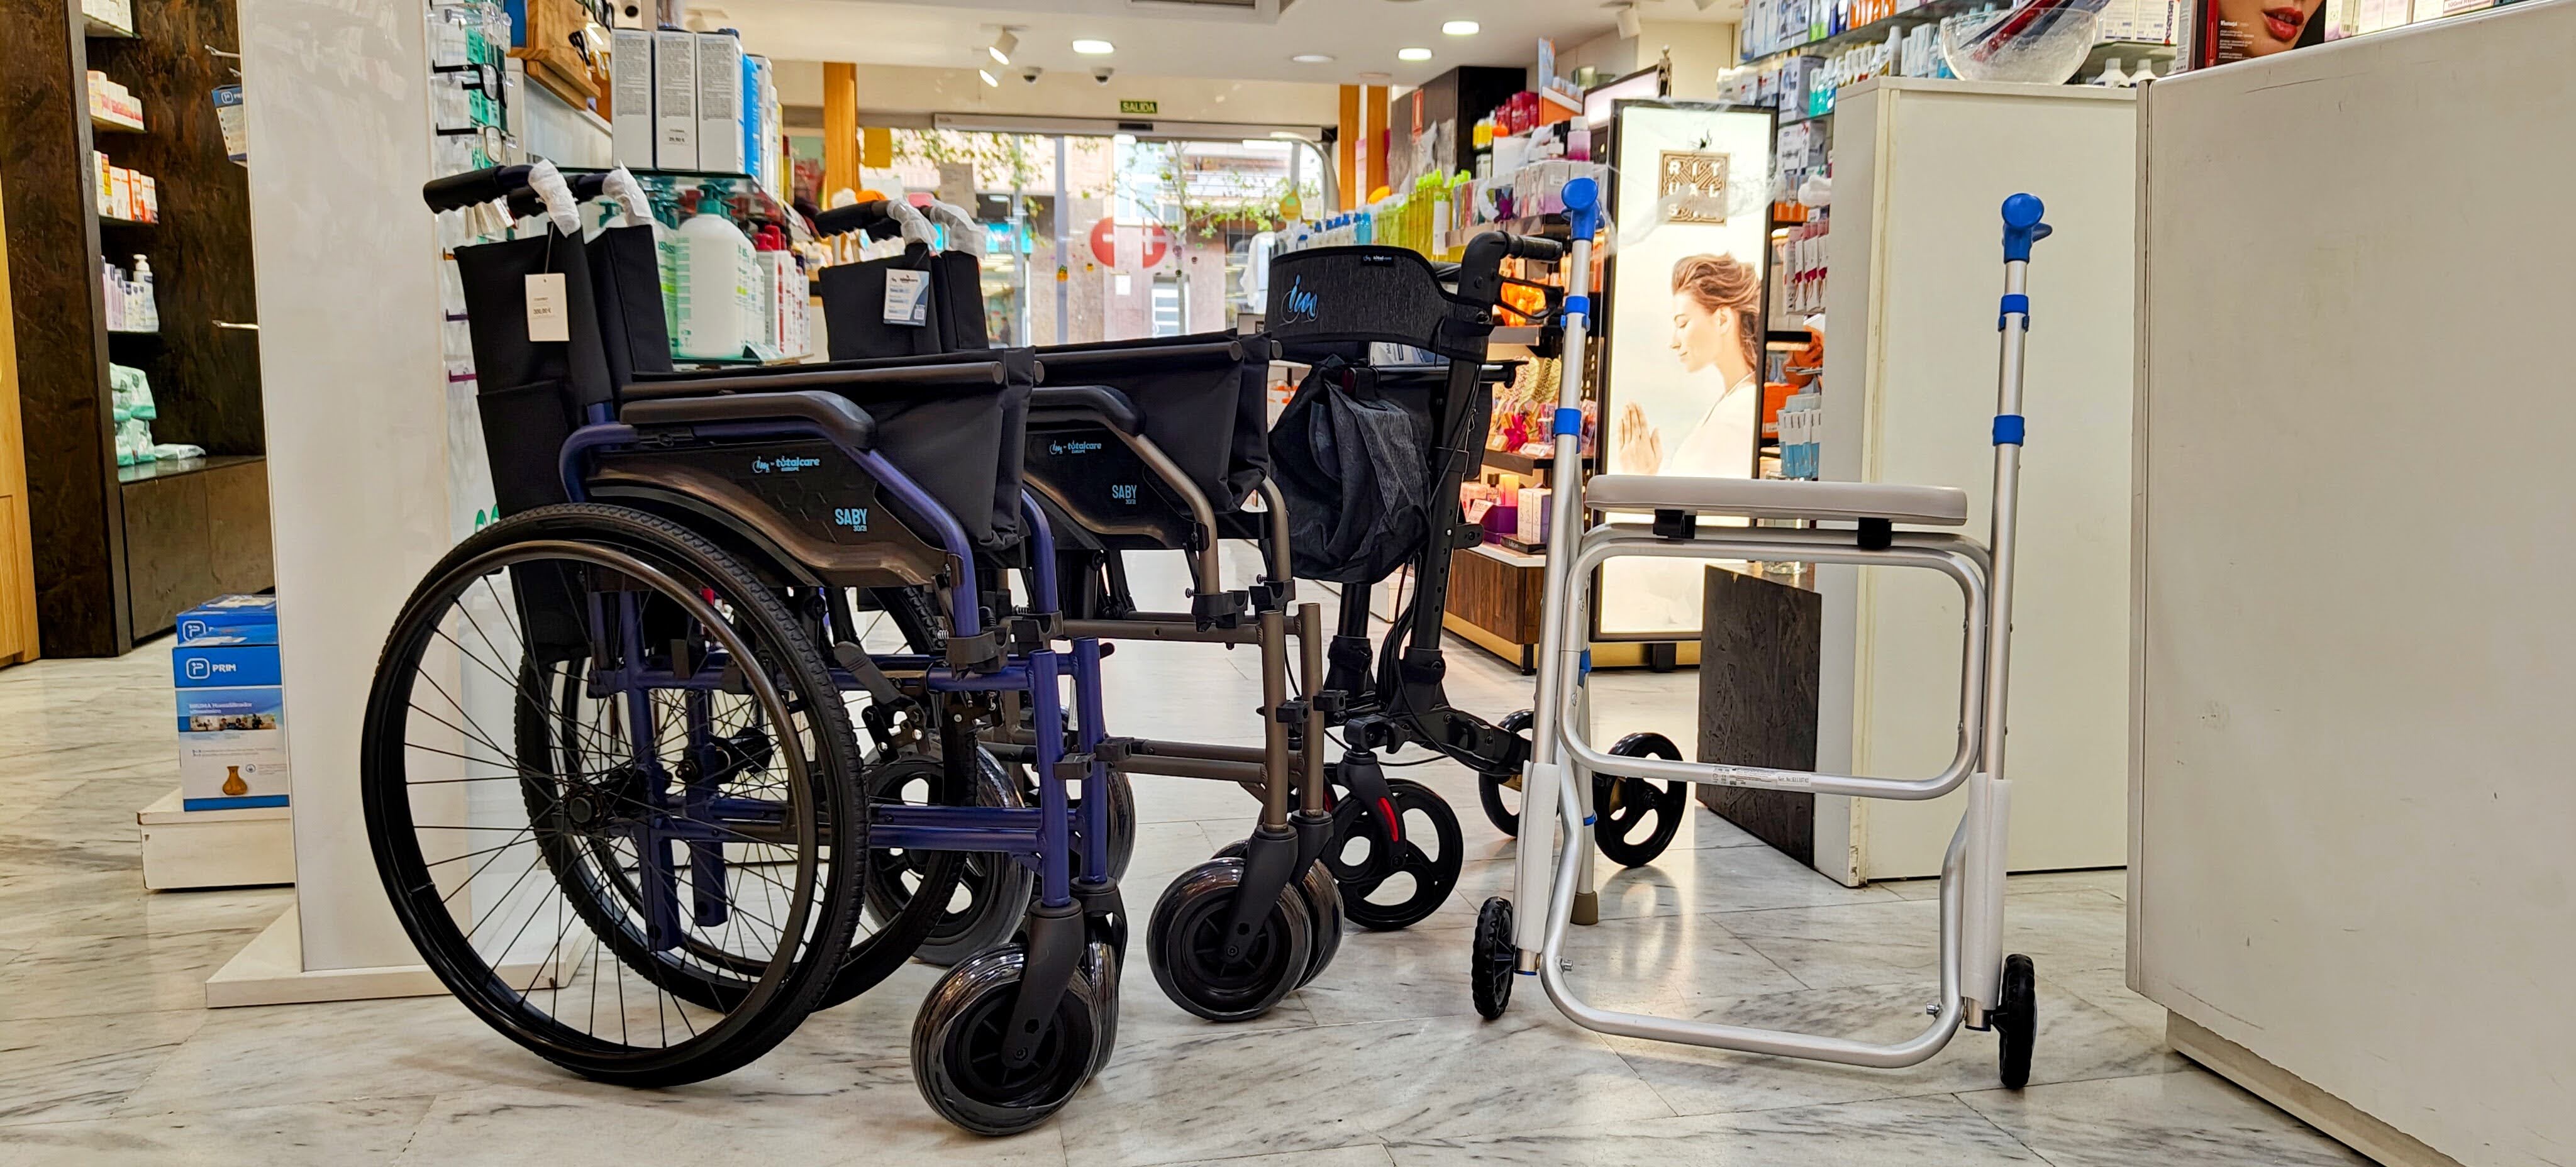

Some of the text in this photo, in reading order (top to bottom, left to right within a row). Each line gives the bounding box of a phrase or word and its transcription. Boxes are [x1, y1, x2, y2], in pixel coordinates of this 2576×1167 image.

[1123, 102, 1155, 112] SALIDA
[1112, 485, 1137, 499] SABY
[835, 508, 867, 525] SABY
[212, 664, 236, 672] PRIM
